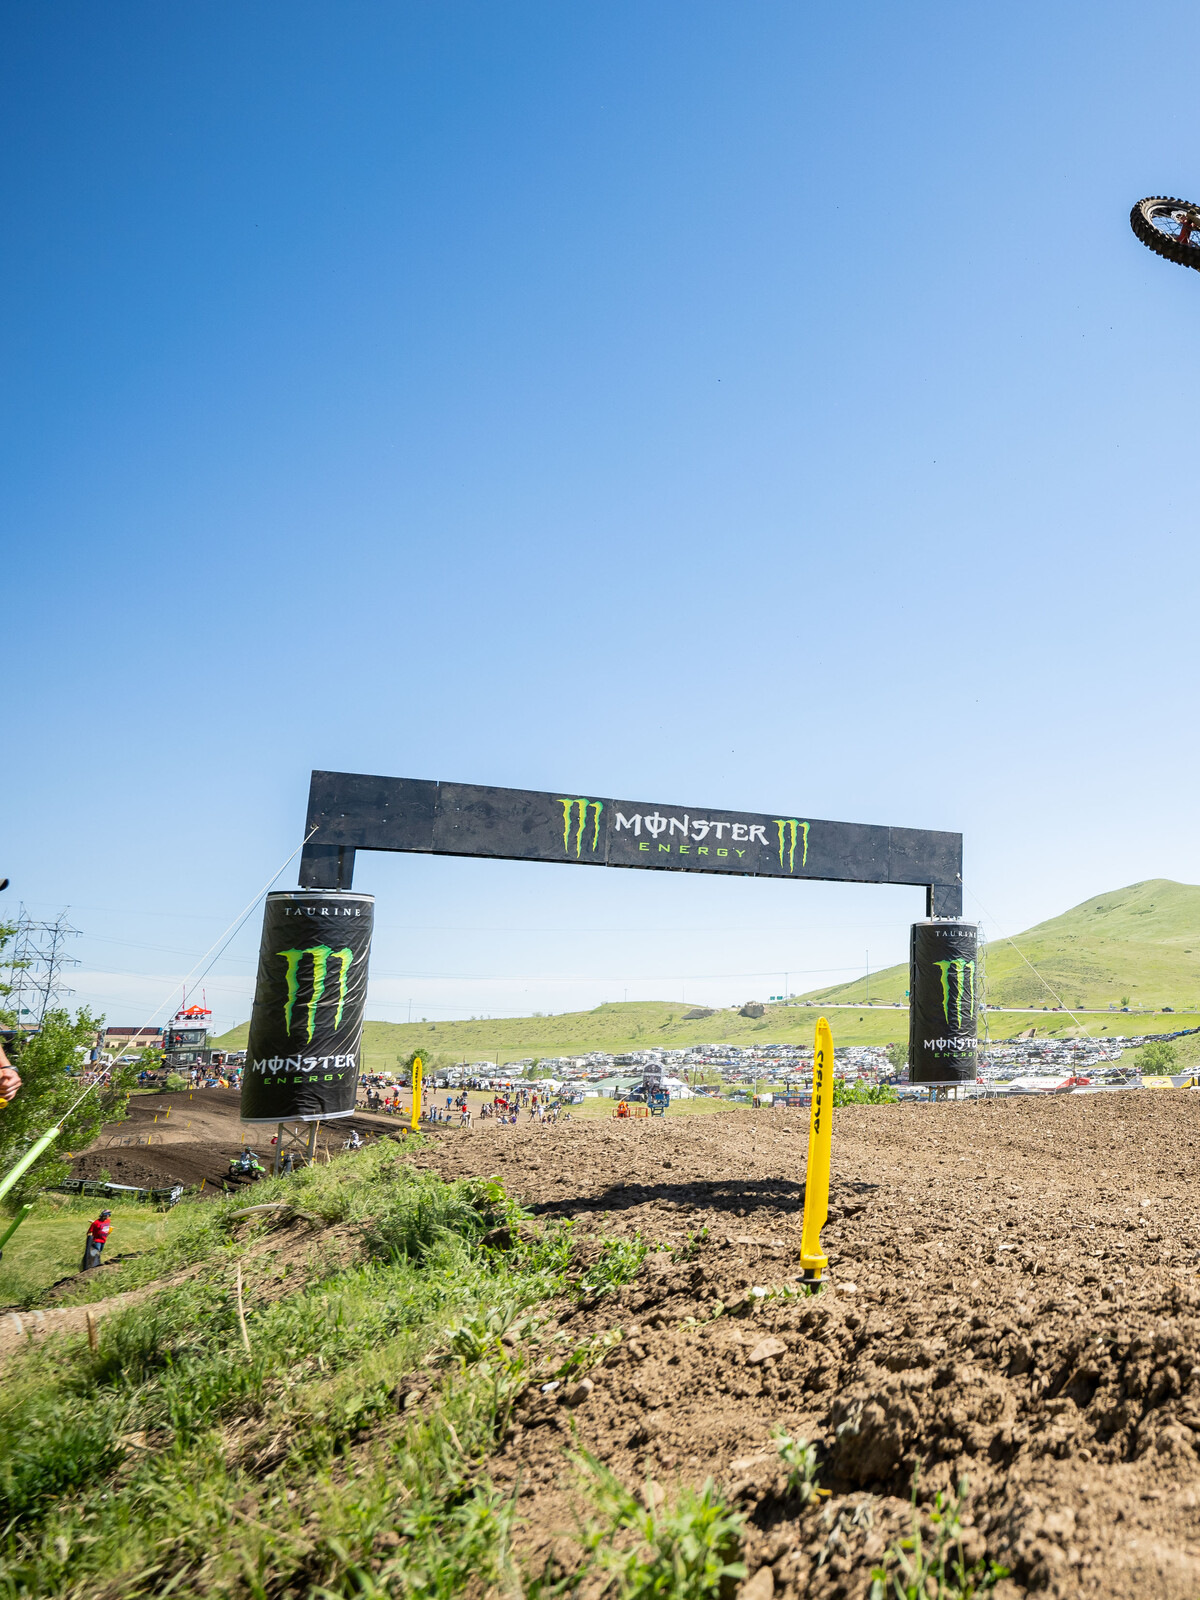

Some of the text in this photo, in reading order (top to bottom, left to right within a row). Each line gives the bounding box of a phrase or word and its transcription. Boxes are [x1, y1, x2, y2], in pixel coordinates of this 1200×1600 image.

[614, 811, 770, 846] MONSTER
[638, 842, 746, 858] ENERGY
[285, 907, 361, 917] TAURINE
[252, 1053, 356, 1075] MONSTER
[263, 1073, 345, 1085] ENERGY
